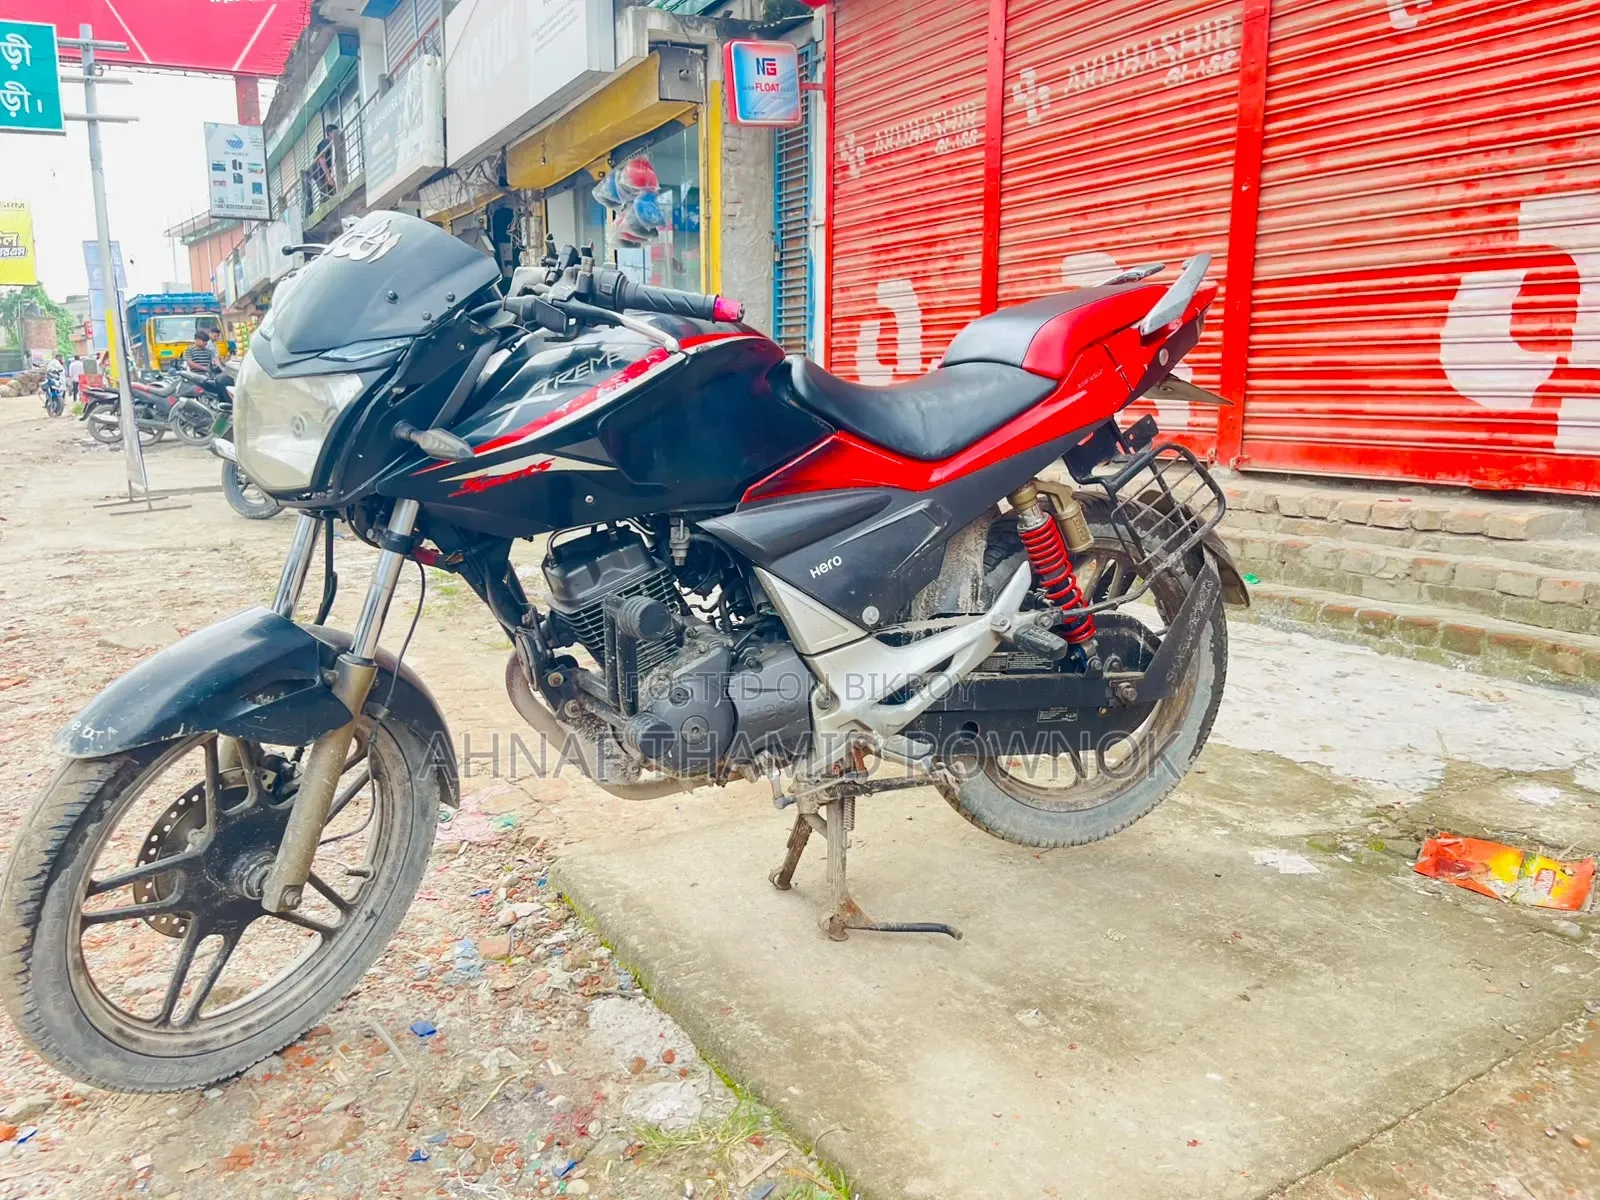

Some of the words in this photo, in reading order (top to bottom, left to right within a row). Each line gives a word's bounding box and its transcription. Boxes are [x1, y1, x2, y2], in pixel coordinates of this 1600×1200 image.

[755, 82, 780, 92] FLOAT
[488, 350, 624, 437] XTREME
[809, 555, 842, 579] Hero
